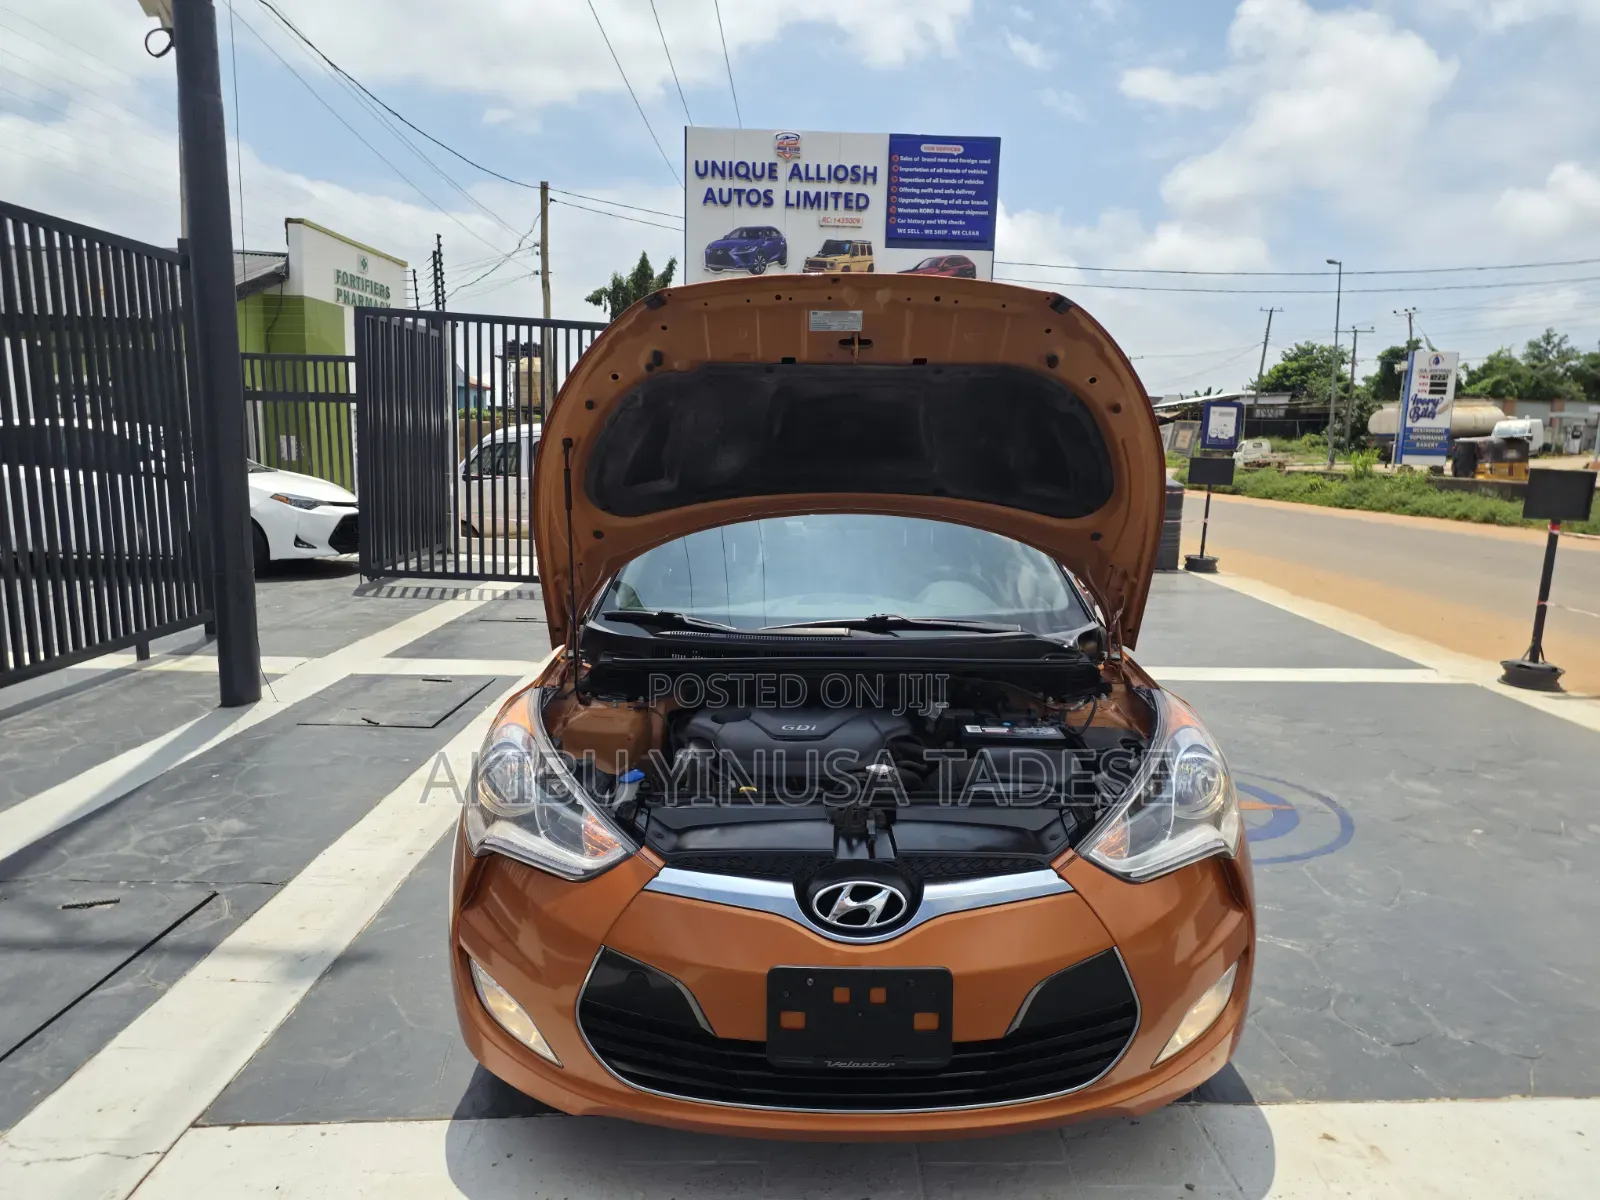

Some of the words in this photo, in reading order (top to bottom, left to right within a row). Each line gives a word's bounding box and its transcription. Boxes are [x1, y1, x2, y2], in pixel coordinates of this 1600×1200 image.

[694, 160, 778, 182] UNIQUE
[788, 163, 878, 186] ALLIOSH
[702, 188, 774, 208] AUTOS
[785, 189, 870, 212] LIMITED
[336, 269, 391, 300] FORTIFIERS
[824, 1060, 896, 1068] Veloster
